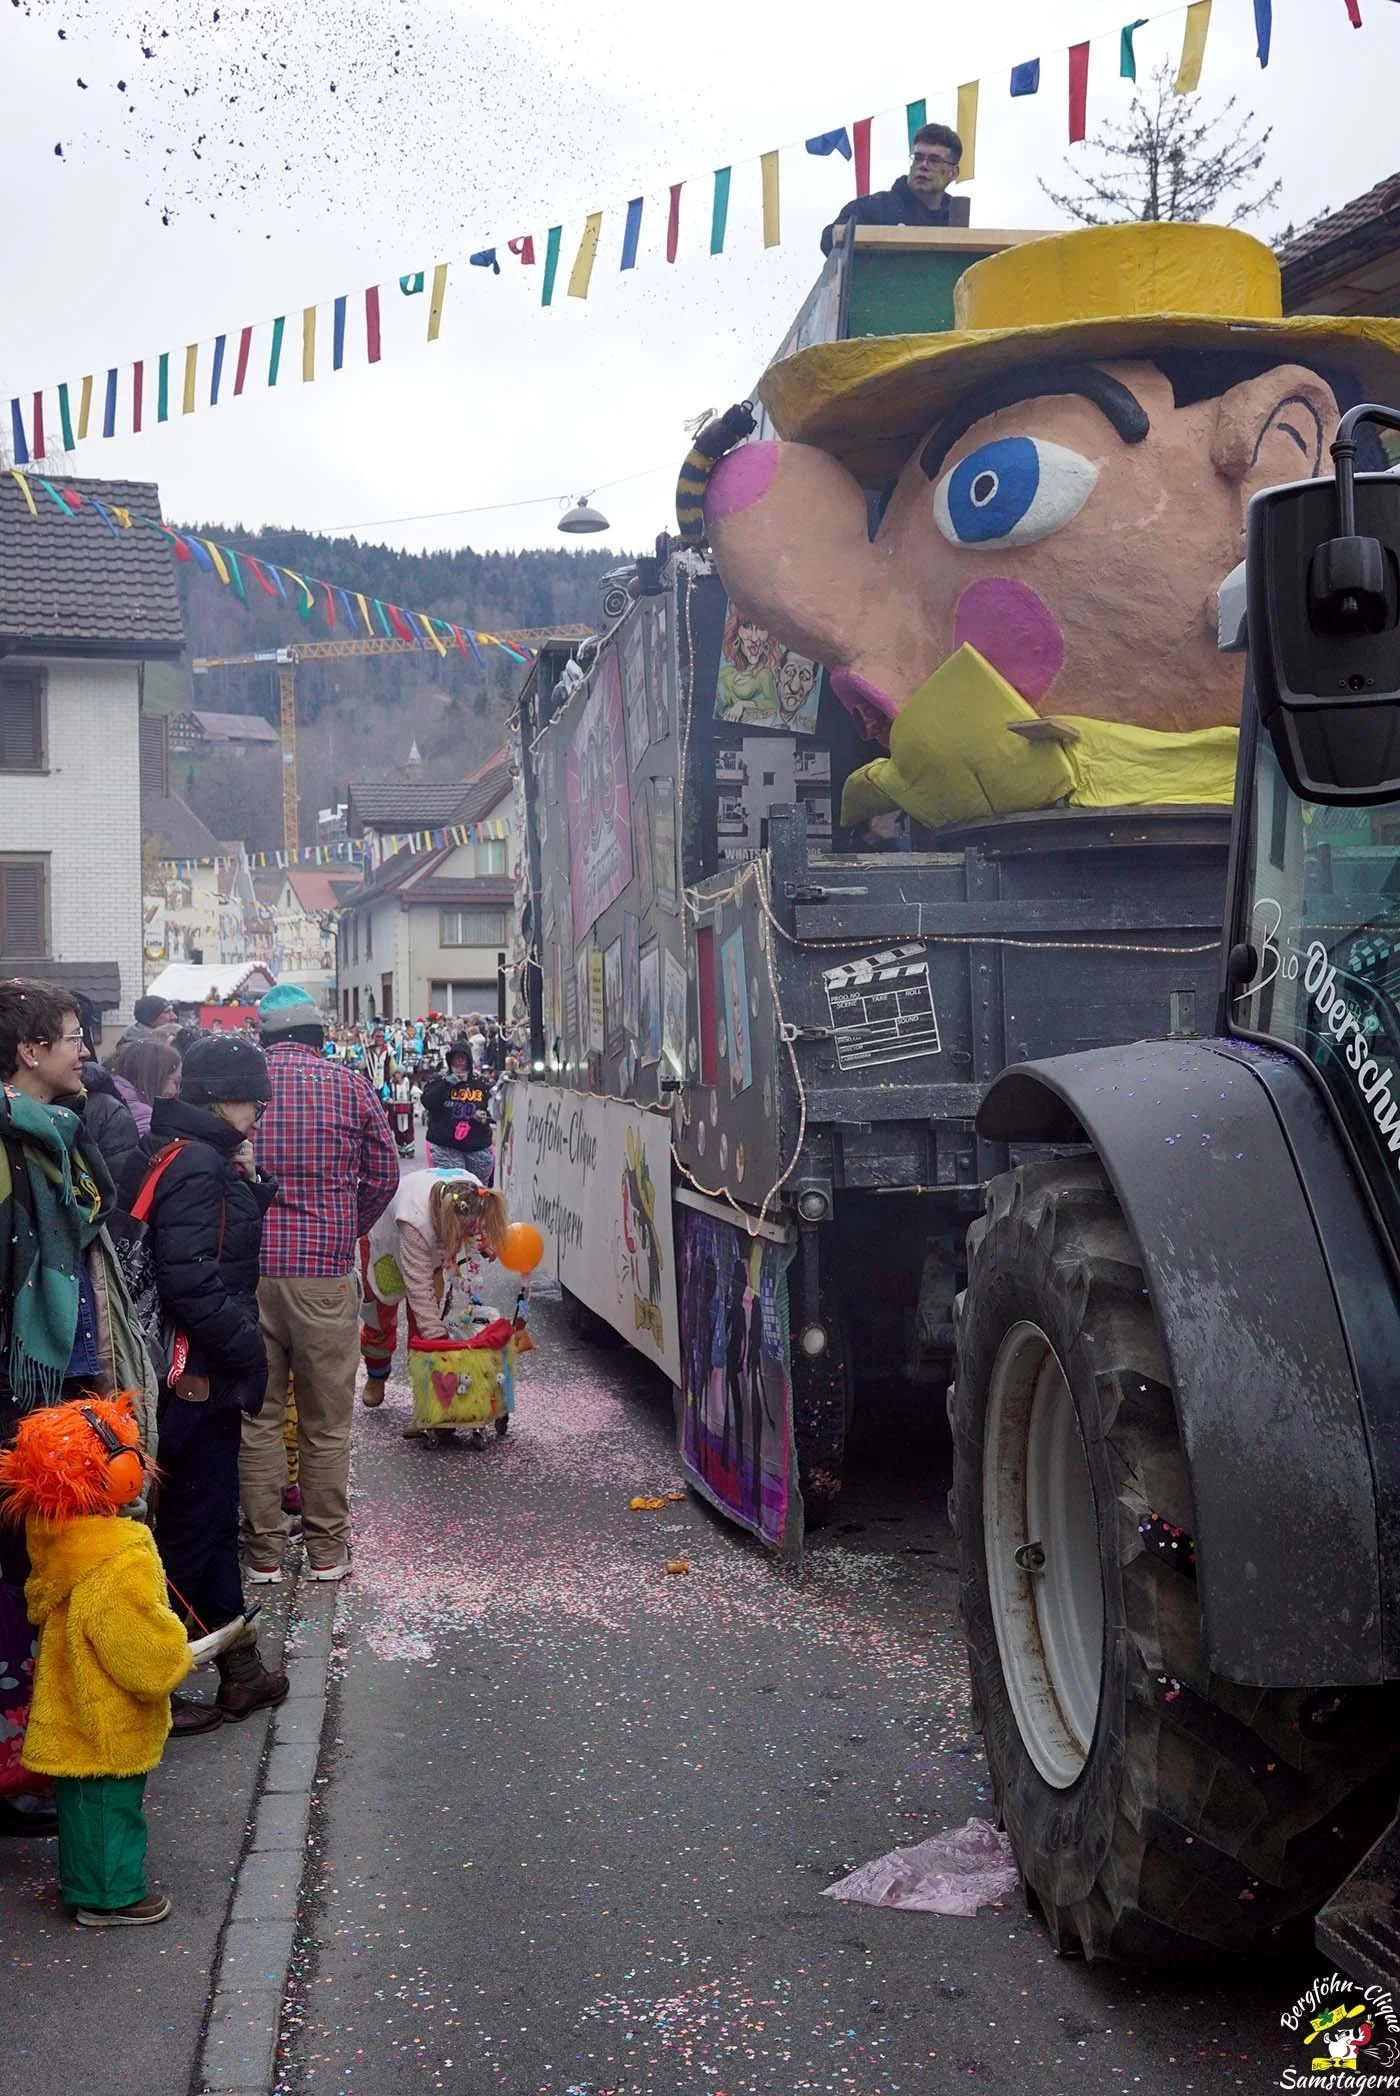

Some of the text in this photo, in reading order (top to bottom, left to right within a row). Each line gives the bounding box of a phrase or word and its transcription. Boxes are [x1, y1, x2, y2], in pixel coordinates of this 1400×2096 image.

[724, 848, 768, 861] WHATSA
[1233, 898, 1298, 1001] Bio
[897, 1015, 919, 1024] SOUND
[1304, 940, 1400, 1172] Oberschw
[450, 1088, 483, 1102] LOVE
